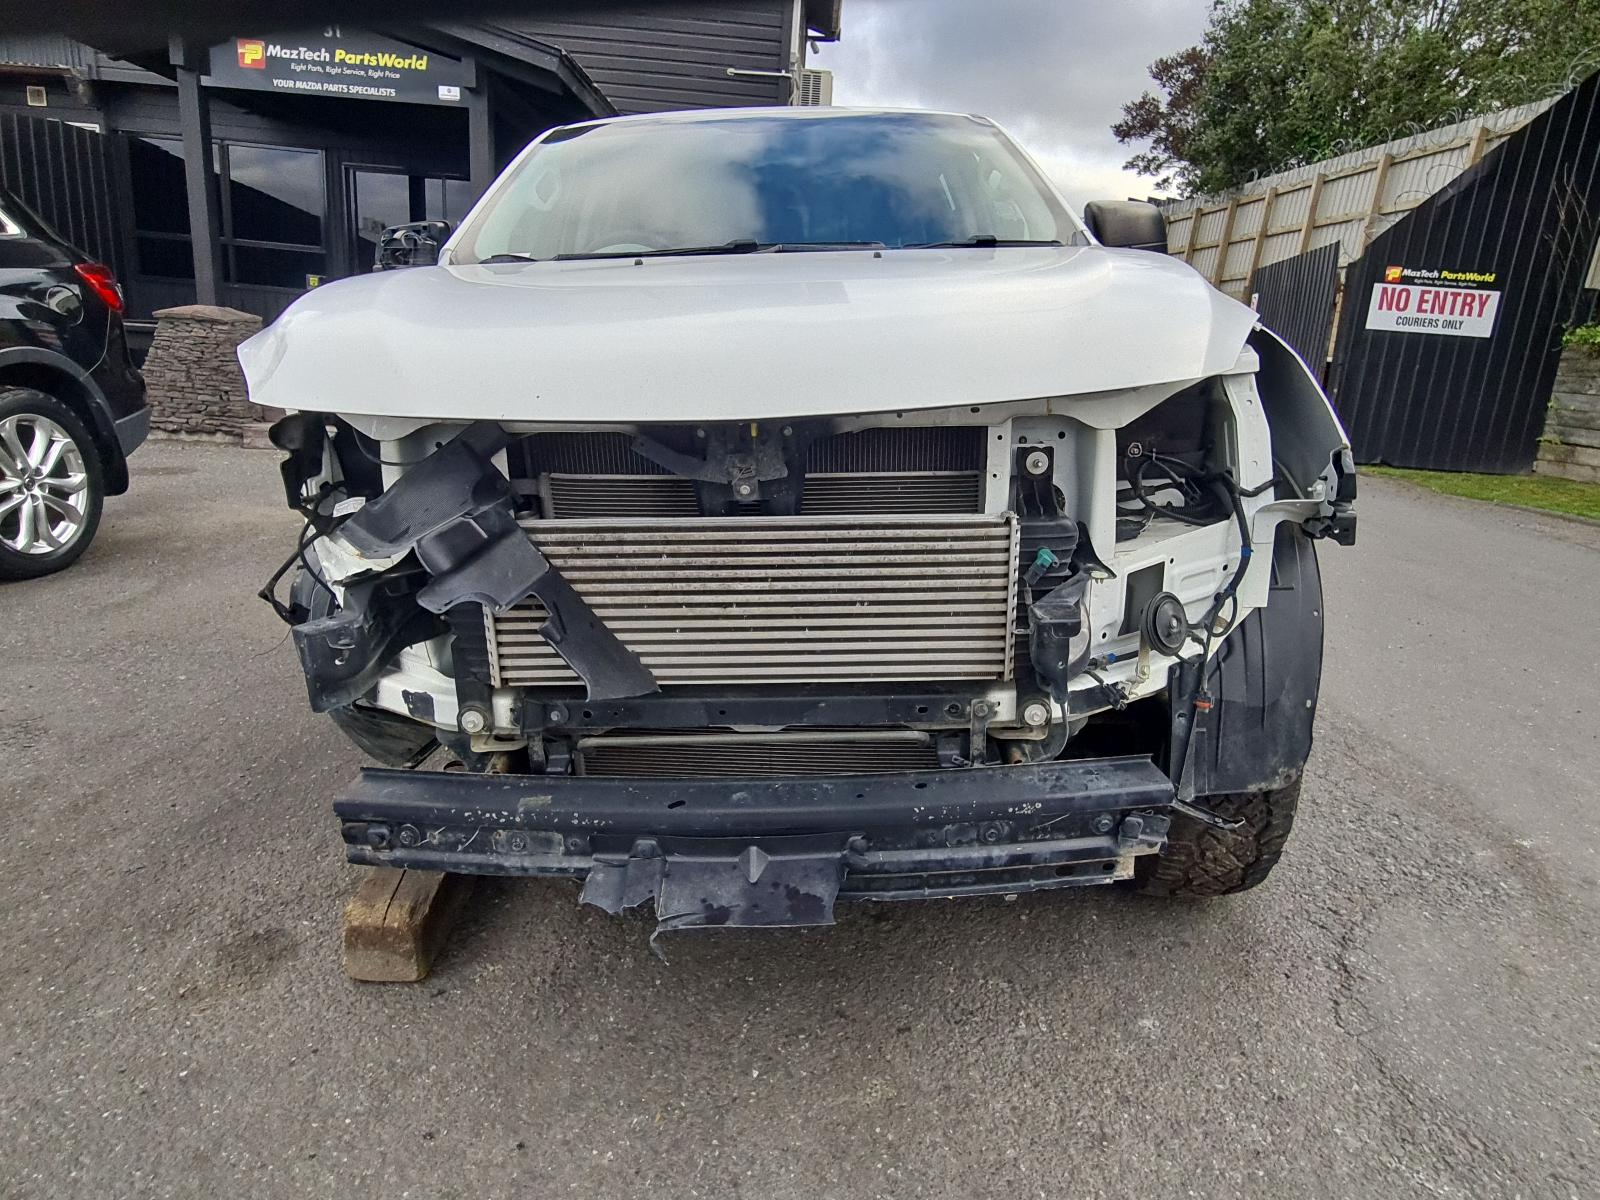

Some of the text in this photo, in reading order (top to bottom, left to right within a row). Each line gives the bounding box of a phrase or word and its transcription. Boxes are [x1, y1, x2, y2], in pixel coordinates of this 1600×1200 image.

[266, 44, 428, 71] MazTech PartsWorld
[290, 63, 307, 72] Right
[325, 65, 342, 75] Right
[342, 67, 367, 77] Service,
[367, 69, 384, 79] Right
[384, 71, 400, 79] Price
[272, 78, 396, 97] YOUR MAZDA PARTS SPECIALISTS
[1401, 268, 1496, 282] MazTech PartsWorld
[1377, 286, 1492, 318] NO ENTRY
[1395, 316, 1465, 330] COURIERS ONLY
